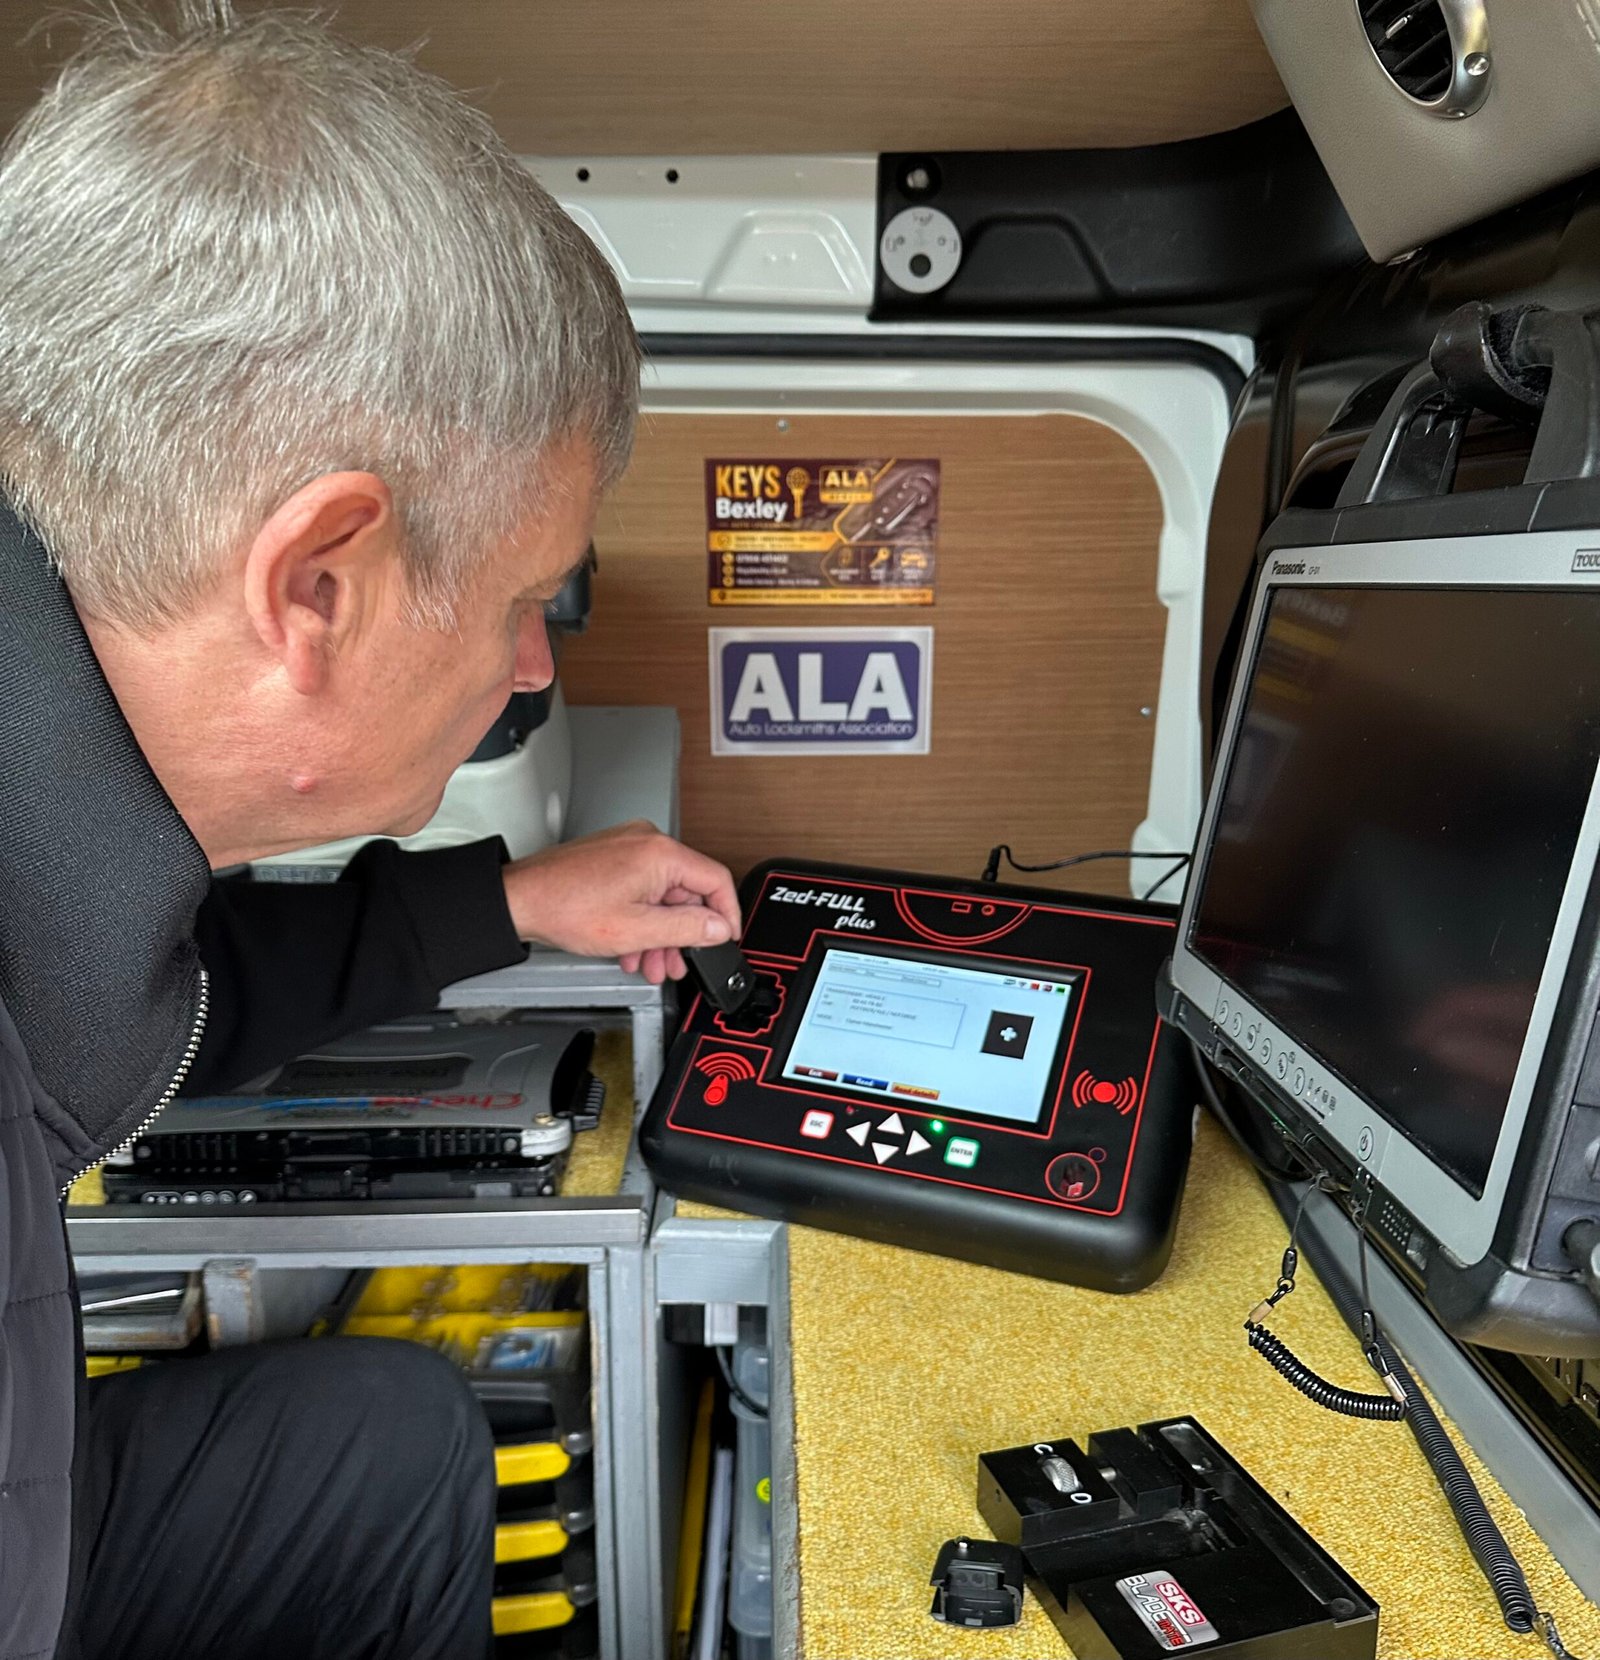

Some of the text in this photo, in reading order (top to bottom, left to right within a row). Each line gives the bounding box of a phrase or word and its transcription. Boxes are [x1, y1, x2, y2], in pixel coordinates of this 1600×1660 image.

[715, 465, 782, 498] KEYS
[825, 470, 869, 488] ALA
[715, 496, 788, 523] Bexley
[1272, 559, 1306, 576] Panasonic
[729, 652, 914, 722] ALA
[729, 722, 913, 736] Auto Locksmiths Association
[769, 886, 865, 912] Zed-FULL
[834, 912, 876, 930] plus
[809, 1119, 824, 1129] ESC
[949, 1146, 974, 1158] ENTER
[1158, 1582, 1202, 1625] SKS
